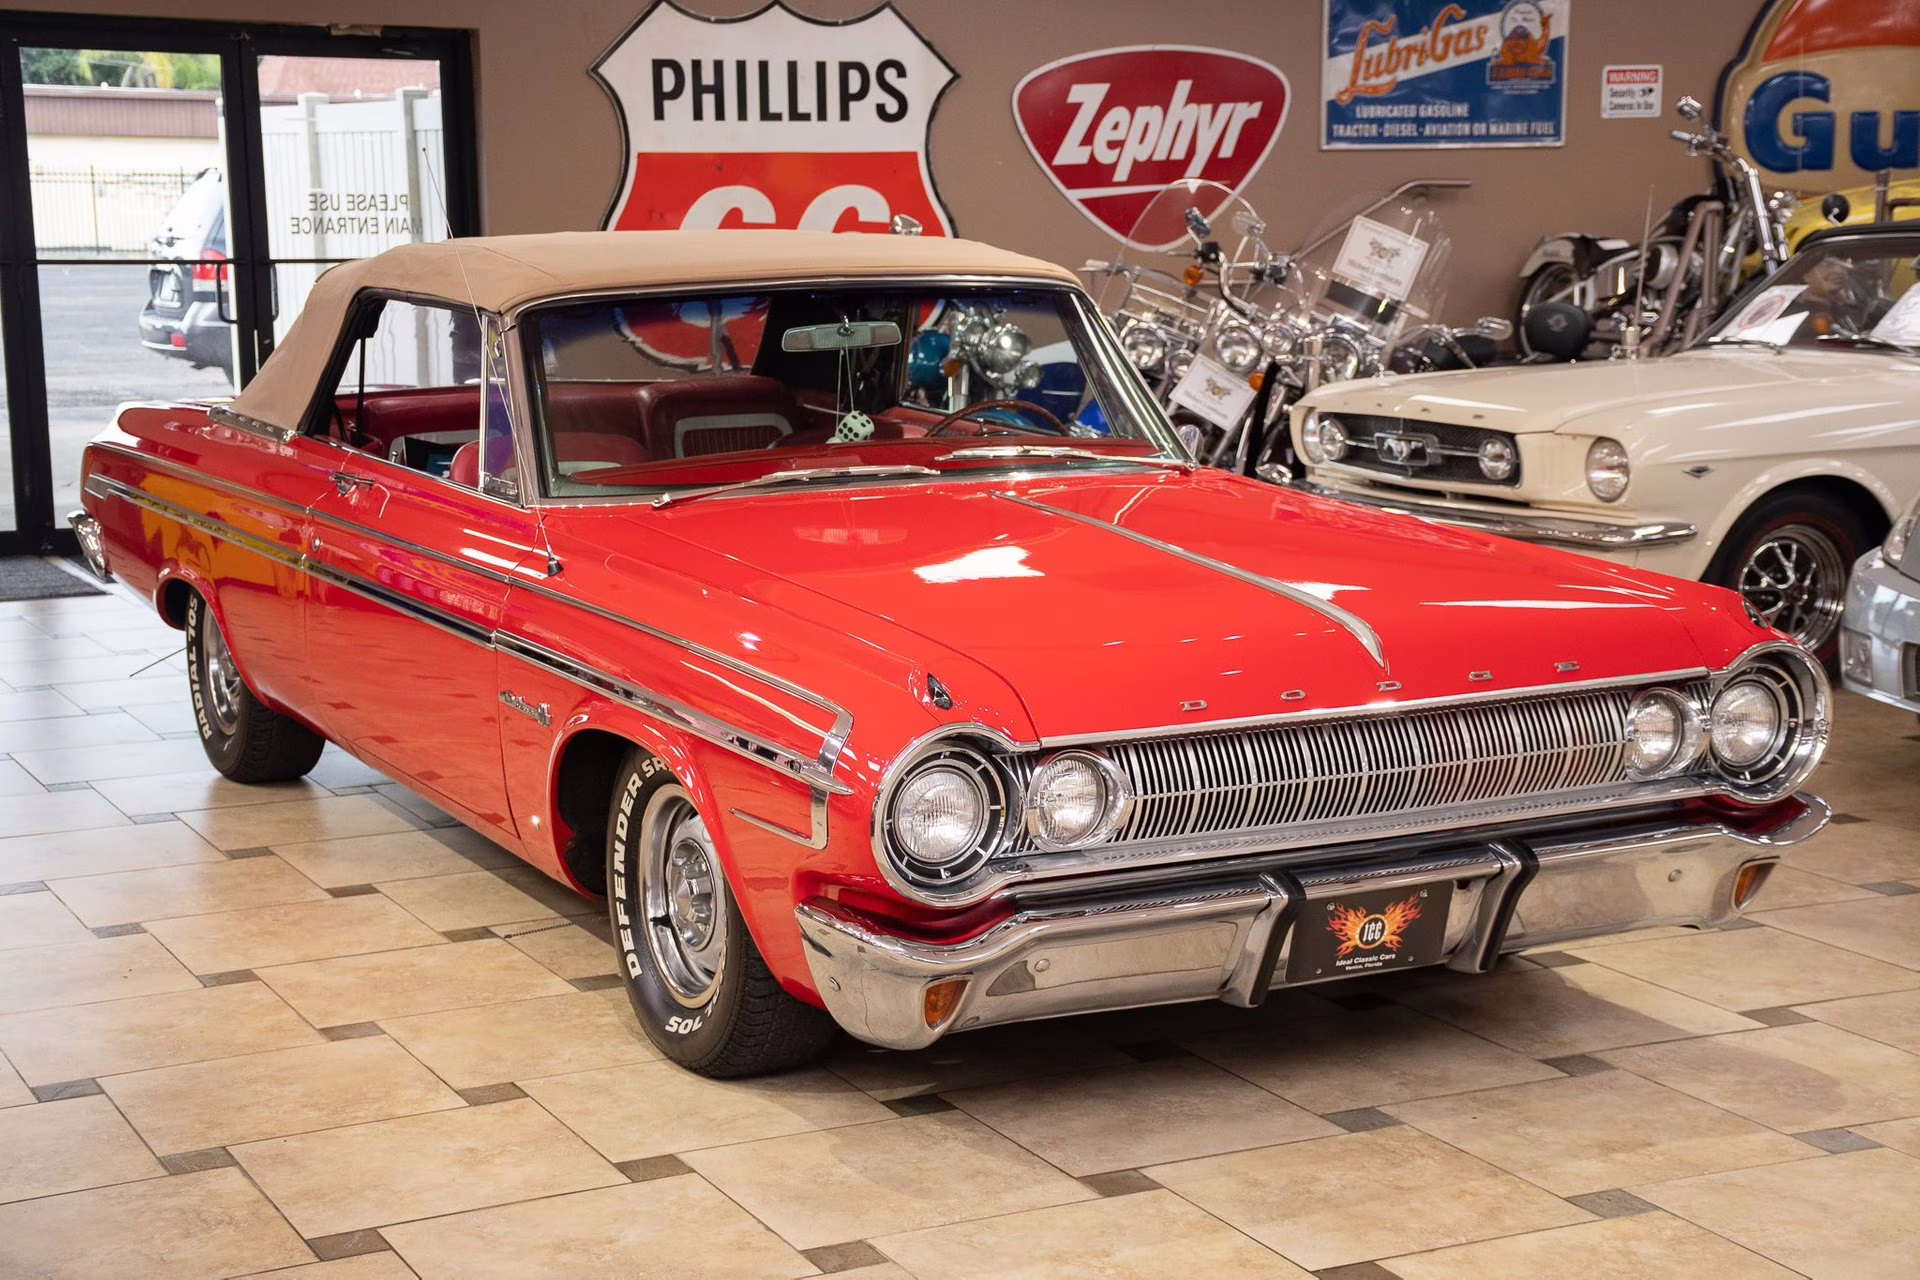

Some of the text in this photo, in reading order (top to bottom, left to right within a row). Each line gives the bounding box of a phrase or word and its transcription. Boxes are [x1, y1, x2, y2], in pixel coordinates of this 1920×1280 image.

[1608, 70, 1657, 83] WARNING
[651, 58, 909, 123] PHILLIPS
[1355, 103, 1469, 119] LUBRICATED GASOLINE
[1051, 79, 1263, 190] Zephyr
[1488, 122, 1528, 136] MARINE
[1529, 121, 1555, 136] FUEL
[188, 645, 213, 741] RADIAL
[611, 772, 644, 980] DEFENDER
[1335, 953, 1396, 967] Ideal Classic Cars
[664, 1015, 703, 1035] 70S
